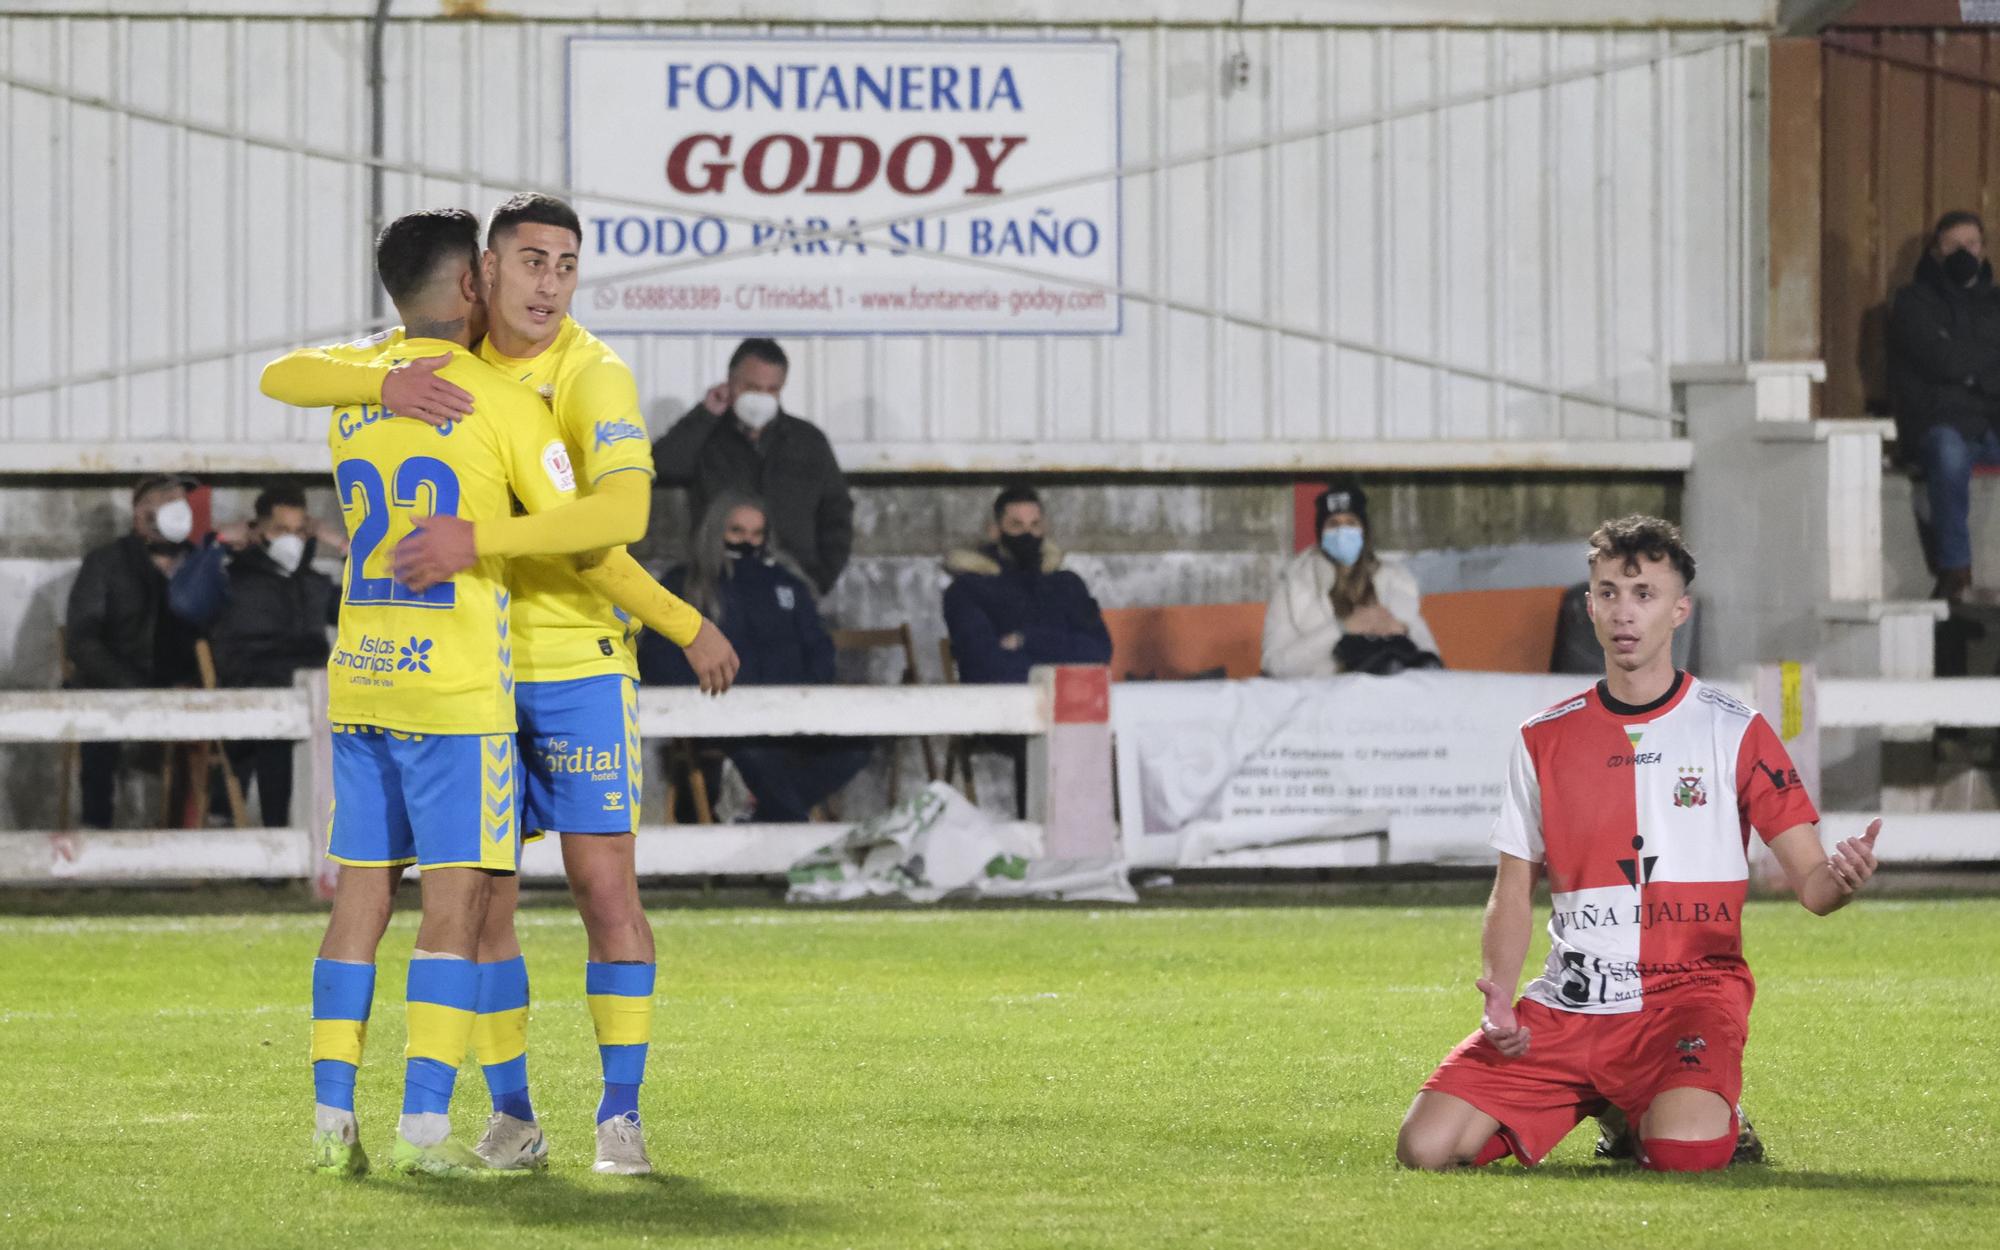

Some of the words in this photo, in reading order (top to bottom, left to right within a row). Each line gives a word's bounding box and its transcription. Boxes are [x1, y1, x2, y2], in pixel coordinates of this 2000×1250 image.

[666, 62, 1024, 112] FONTANERIA
[665, 133, 1027, 196] GODOY
[589, 215, 728, 258] TODO
[751, 217, 869, 257] PARA
[889, 216, 948, 258] SU
[969, 208, 1100, 259] BAÑO
[334, 455, 461, 609] 22
[360, 634, 395, 654] Islas
[333, 650, 394, 673] anarias
[537, 743, 623, 774] ordial
[1606, 754, 1622, 769] CD
[591, 770, 619, 782] hotels
[1557, 903, 1619, 930] VIÑA
[1633, 901, 1733, 930] IJALBA
